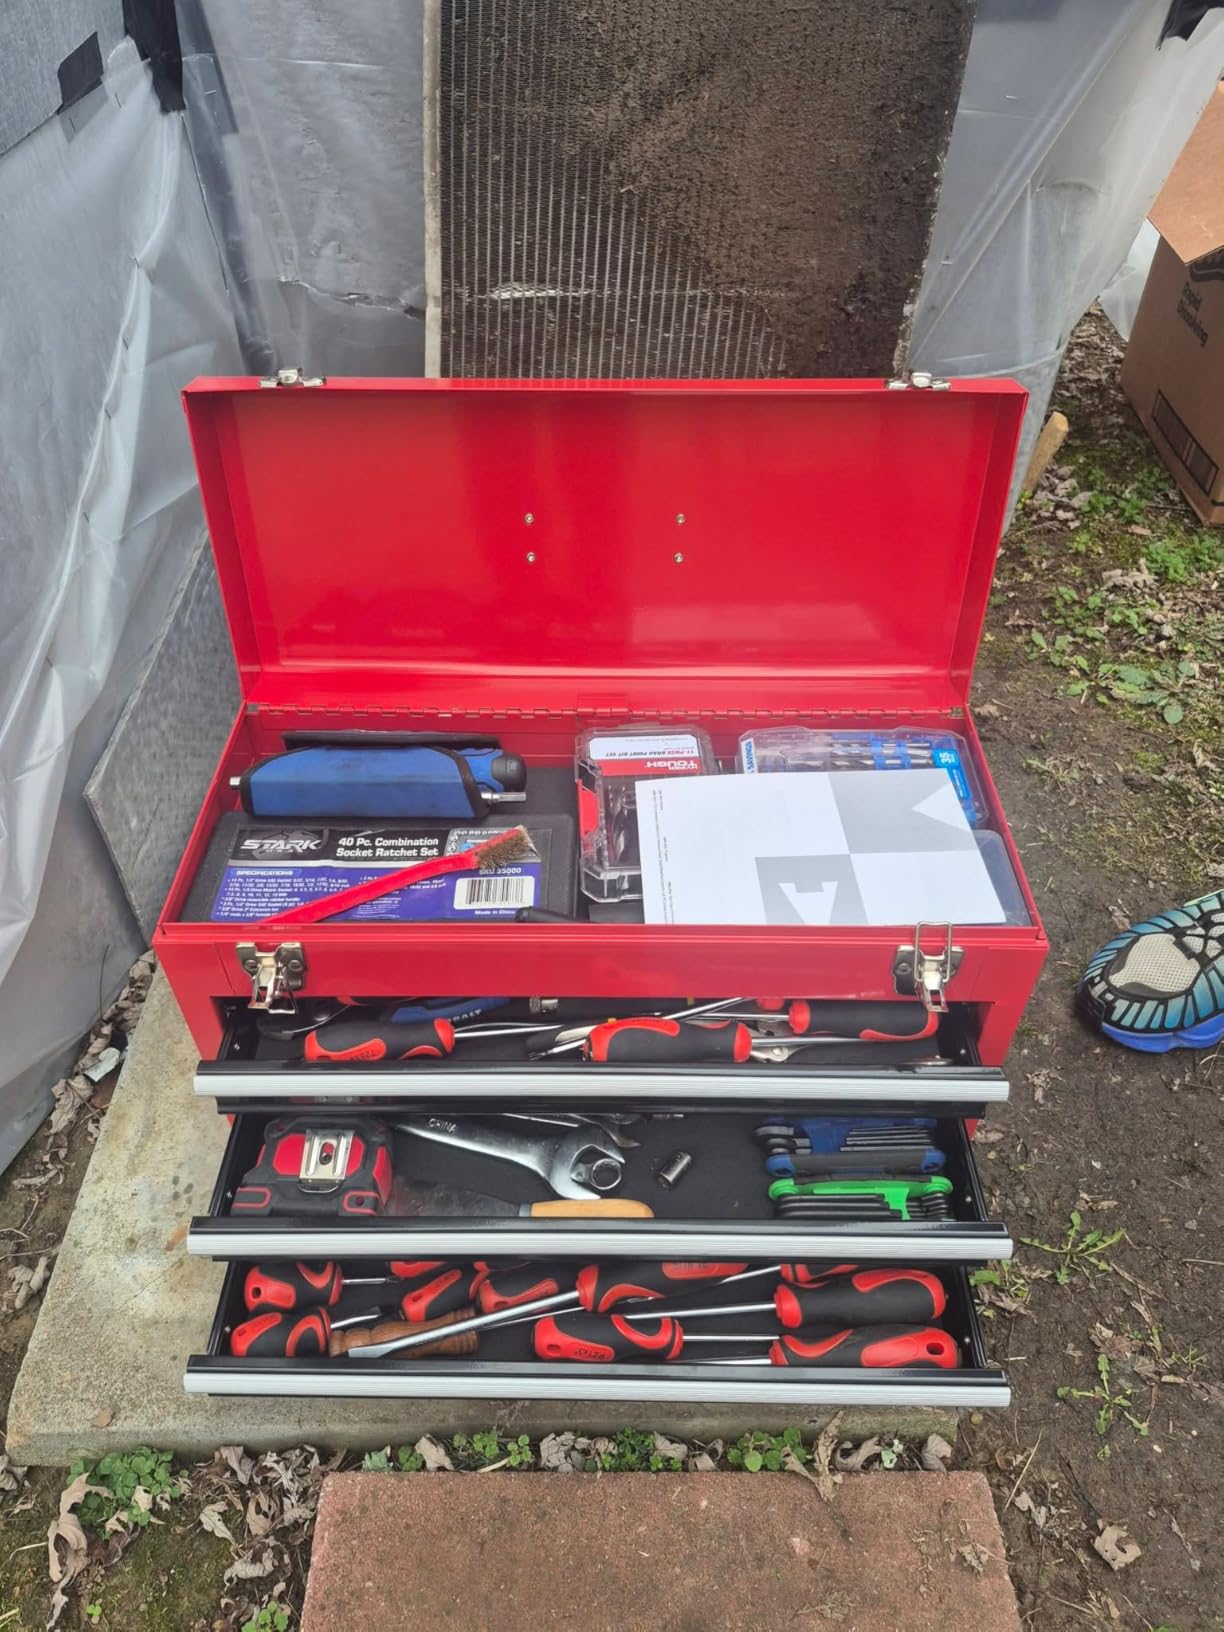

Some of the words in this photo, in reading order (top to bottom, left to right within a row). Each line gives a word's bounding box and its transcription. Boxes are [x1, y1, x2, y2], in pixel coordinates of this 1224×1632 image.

[743, 741, 755, 770] SAVINGS
[645, 760, 698, 771] TOUGH
[241, 839, 323, 853] STARK
[338, 837, 354, 847] 40
[356, 837, 372, 847] Pc.
[375, 837, 439, 847] Combination
[336, 847, 374, 857] Socket
[375, 847, 418, 857] Ratchet
[420, 847, 439, 856] Set
[496, 867, 522, 875] 35000
[447, 1008, 484, 1024] BALT
[427, 1117, 457, 1134] CHINA
